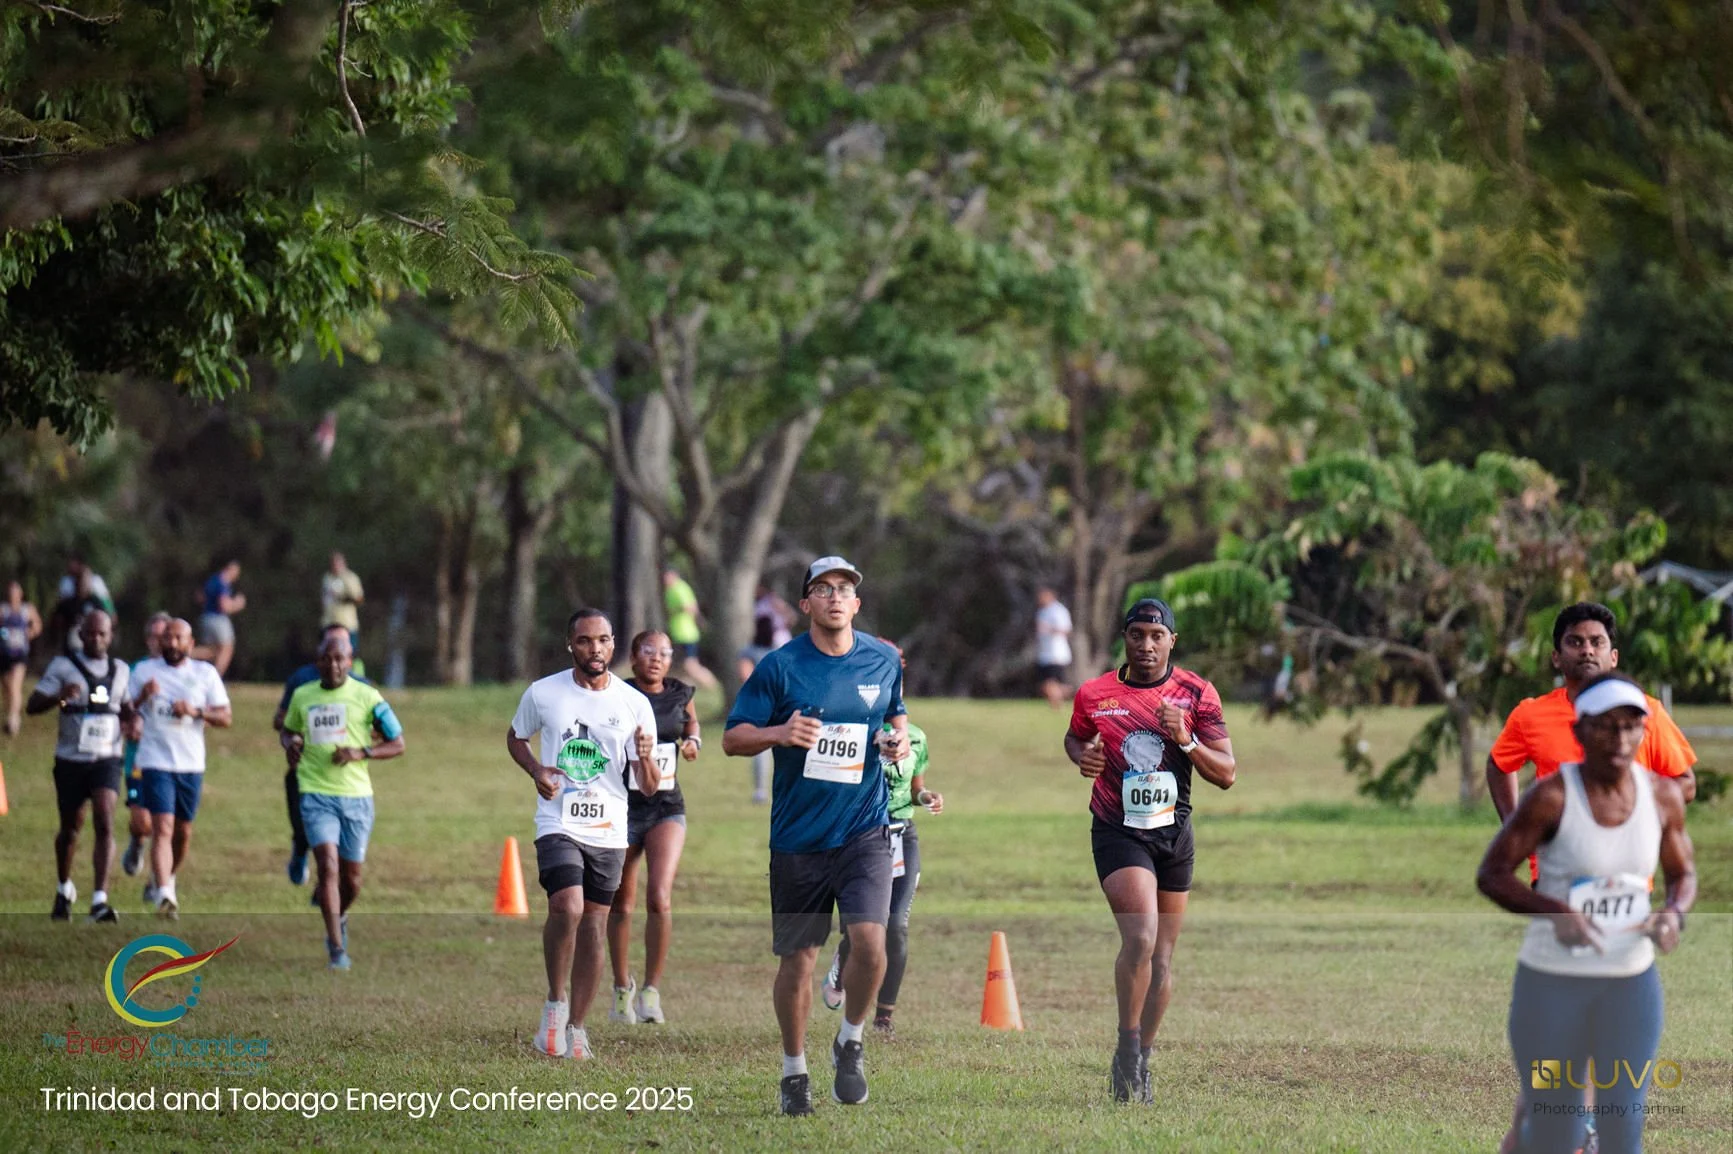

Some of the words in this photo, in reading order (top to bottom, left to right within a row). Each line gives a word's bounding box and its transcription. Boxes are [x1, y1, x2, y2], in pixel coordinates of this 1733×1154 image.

[314, 714, 339, 728] 0401
[817, 738, 858, 758] 0196
[592, 759, 606, 770] 5K
[1131, 788, 1169, 806] 0641
[570, 802, 605, 818] 0351
[1582, 892, 1634, 917] 0477
